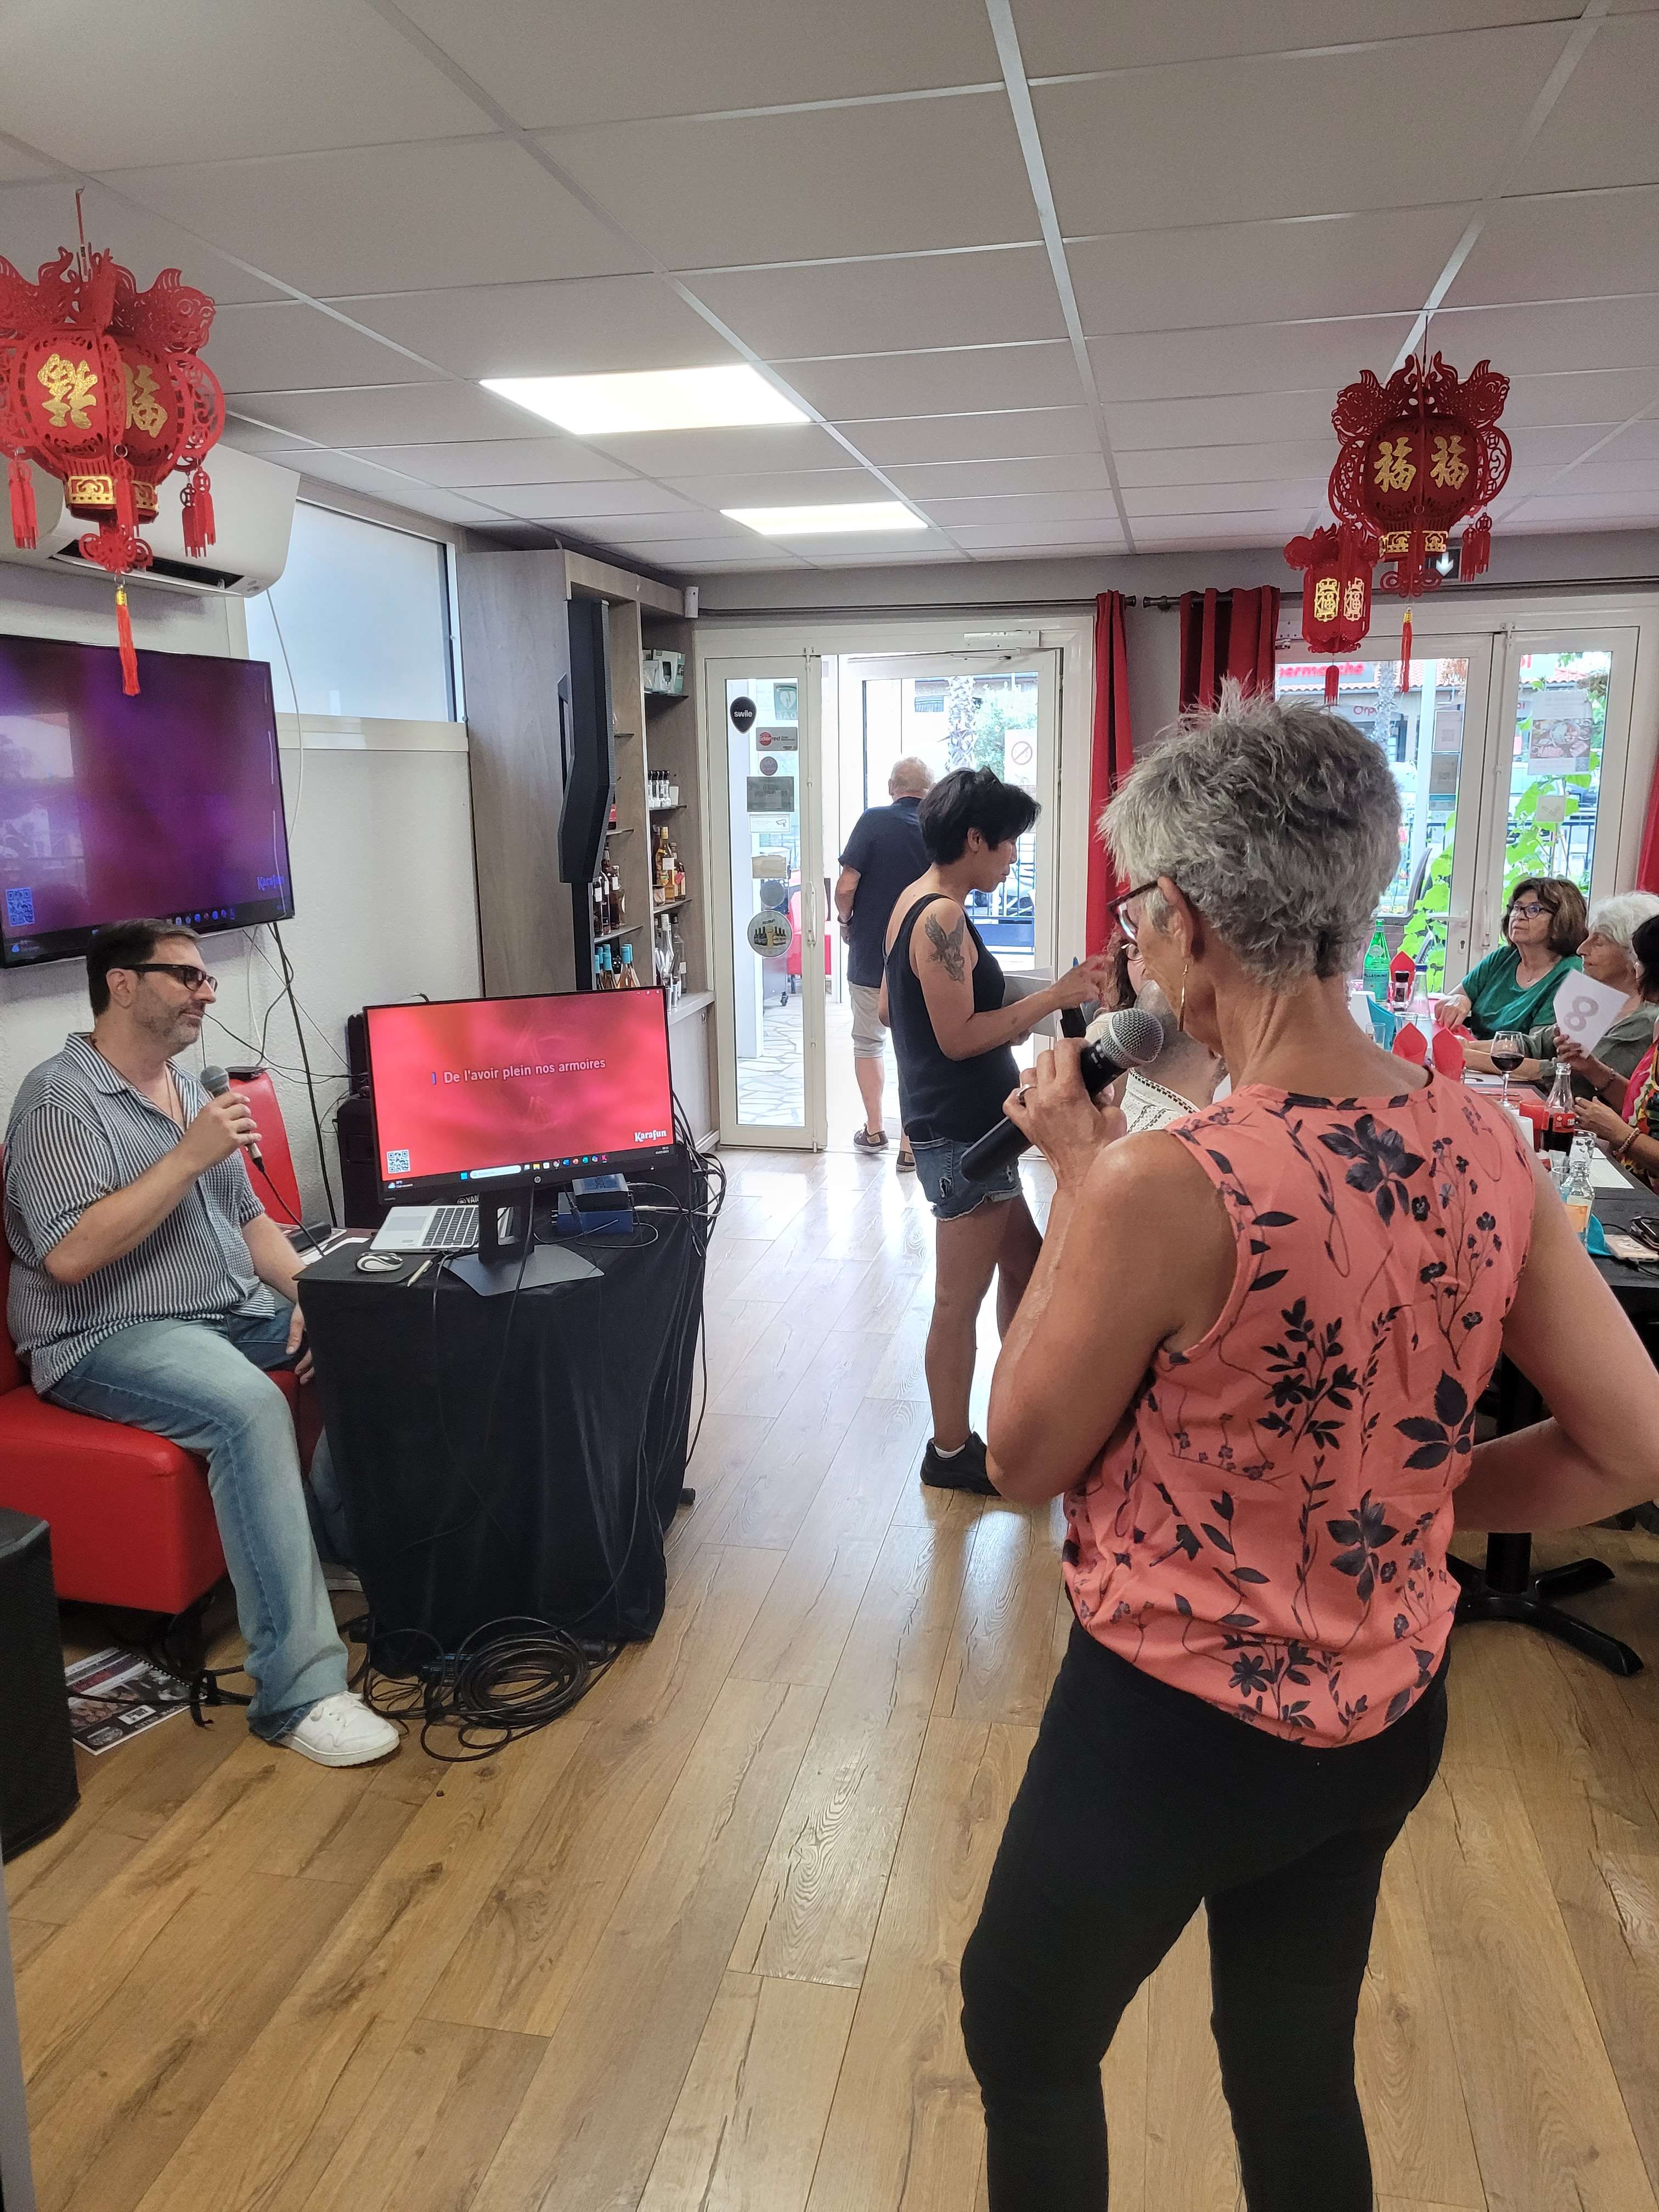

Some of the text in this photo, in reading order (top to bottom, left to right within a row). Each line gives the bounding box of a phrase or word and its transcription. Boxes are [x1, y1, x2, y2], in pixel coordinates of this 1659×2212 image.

[1373, 437, 1417, 493] 福
[1430, 435, 1470, 490] 福
[443, 1059, 606, 1084] De l'avoir plein nos armoires
[634, 1130, 667, 1142] Karafun
